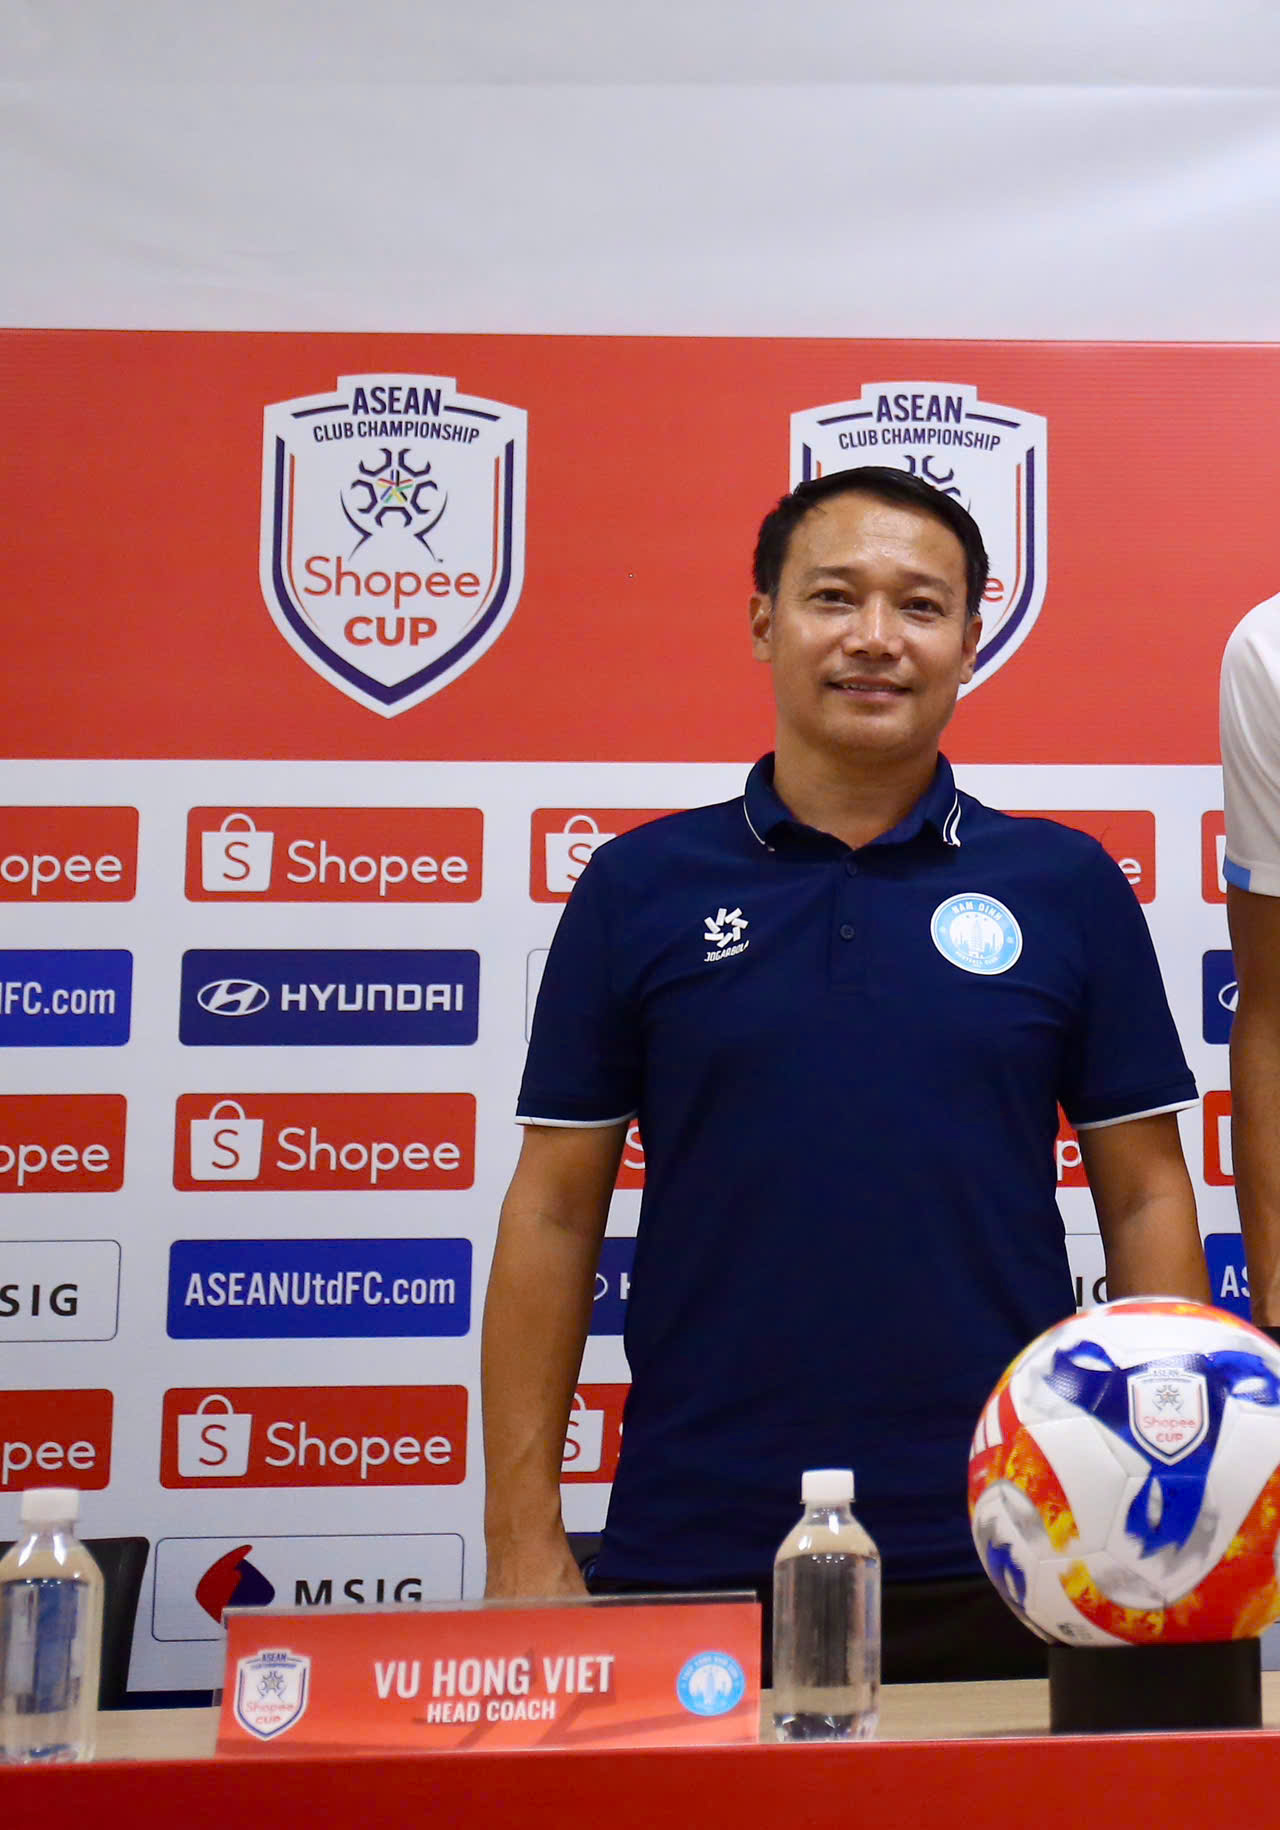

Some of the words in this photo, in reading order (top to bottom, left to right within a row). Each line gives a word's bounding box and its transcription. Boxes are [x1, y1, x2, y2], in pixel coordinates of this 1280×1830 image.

[353, 387, 441, 416] ASEAN
[877, 394, 962, 423] ASEAN
[314, 423, 353, 442] CLUB
[358, 421, 479, 443] CHAMPIONSHIP
[839, 430, 878, 449] CLUB
[882, 428, 1000, 451] CHAMPIONSHIP
[303, 556, 480, 609] Shopee
[344, 616, 437, 646] CUP
[287, 840, 468, 896] Shopee
[951, 901, 974, 914] NAM
[978, 902, 1004, 921] DINH
[0, 982, 115, 1014] FC.com
[282, 984, 463, 1010] HYUNDAI
[277, 1127, 460, 1184] Shopee
[185, 1272, 455, 1305] ASEANUtdFC.com
[265, 1422, 451, 1479] Shopee
[295, 1578, 421, 1605] MSIG
[375, 1661, 420, 1698] VU
[433, 1658, 529, 1697] HONG
[543, 1656, 614, 1693] VIET
[427, 1701, 480, 1723] HEAD
[487, 1699, 556, 1722] COACH
